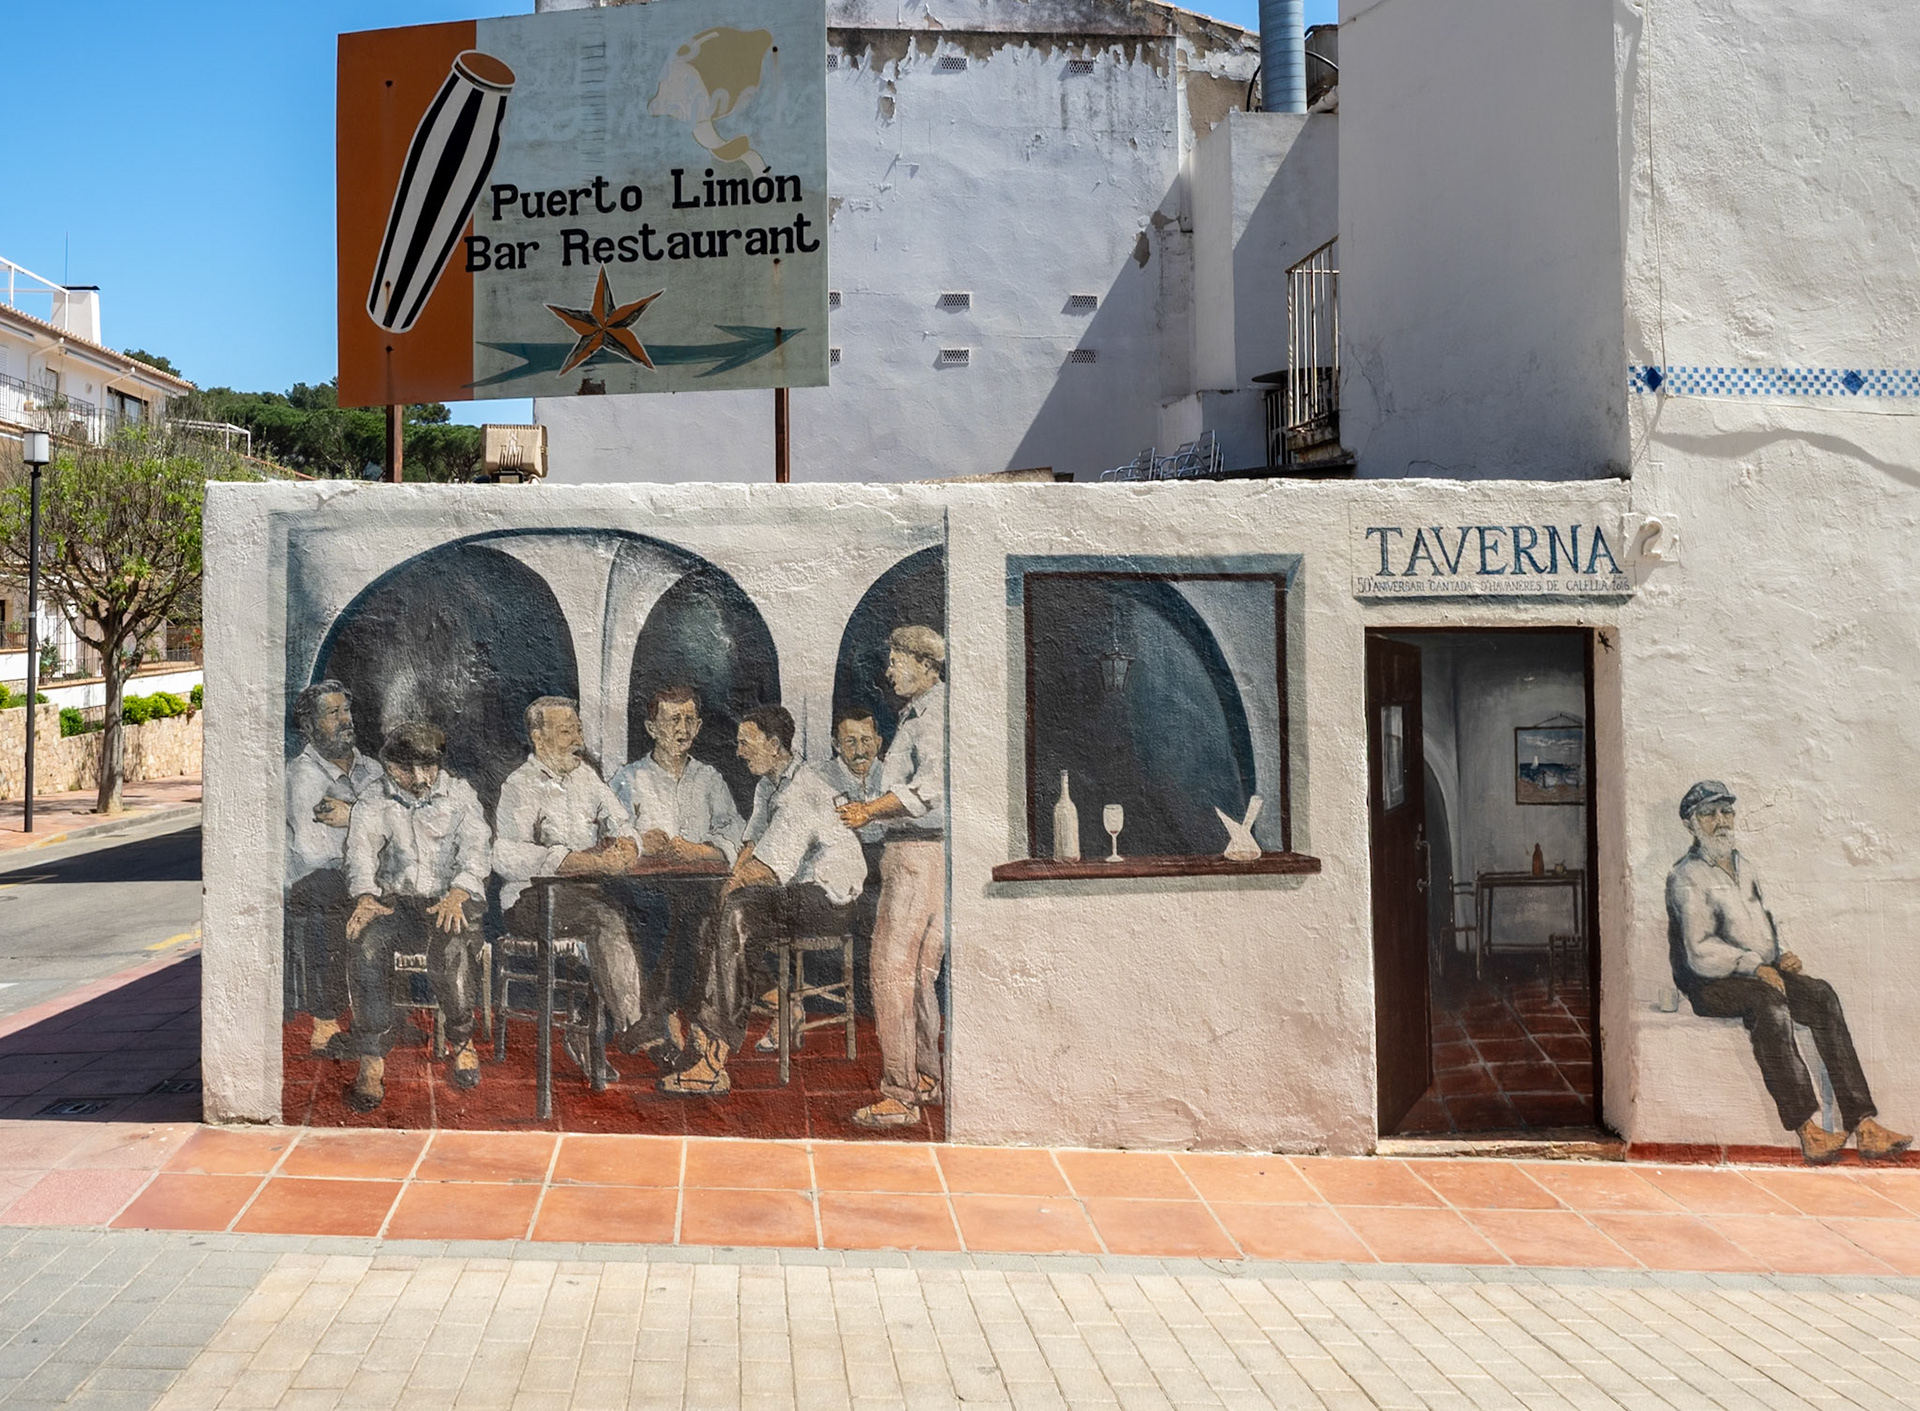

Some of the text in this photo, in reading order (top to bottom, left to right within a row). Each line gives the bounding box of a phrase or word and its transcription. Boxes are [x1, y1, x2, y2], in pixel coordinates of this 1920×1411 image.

[491, 166, 803, 221] Puerto Limón
[464, 212, 821, 273] Bar Restaurant
[1365, 524, 1624, 577] TAVERNA
[1373, 580, 1425, 592] ANIVERSARI
[1546, 579, 1559, 592] DE
[1611, 580, 1630, 591] 2016
